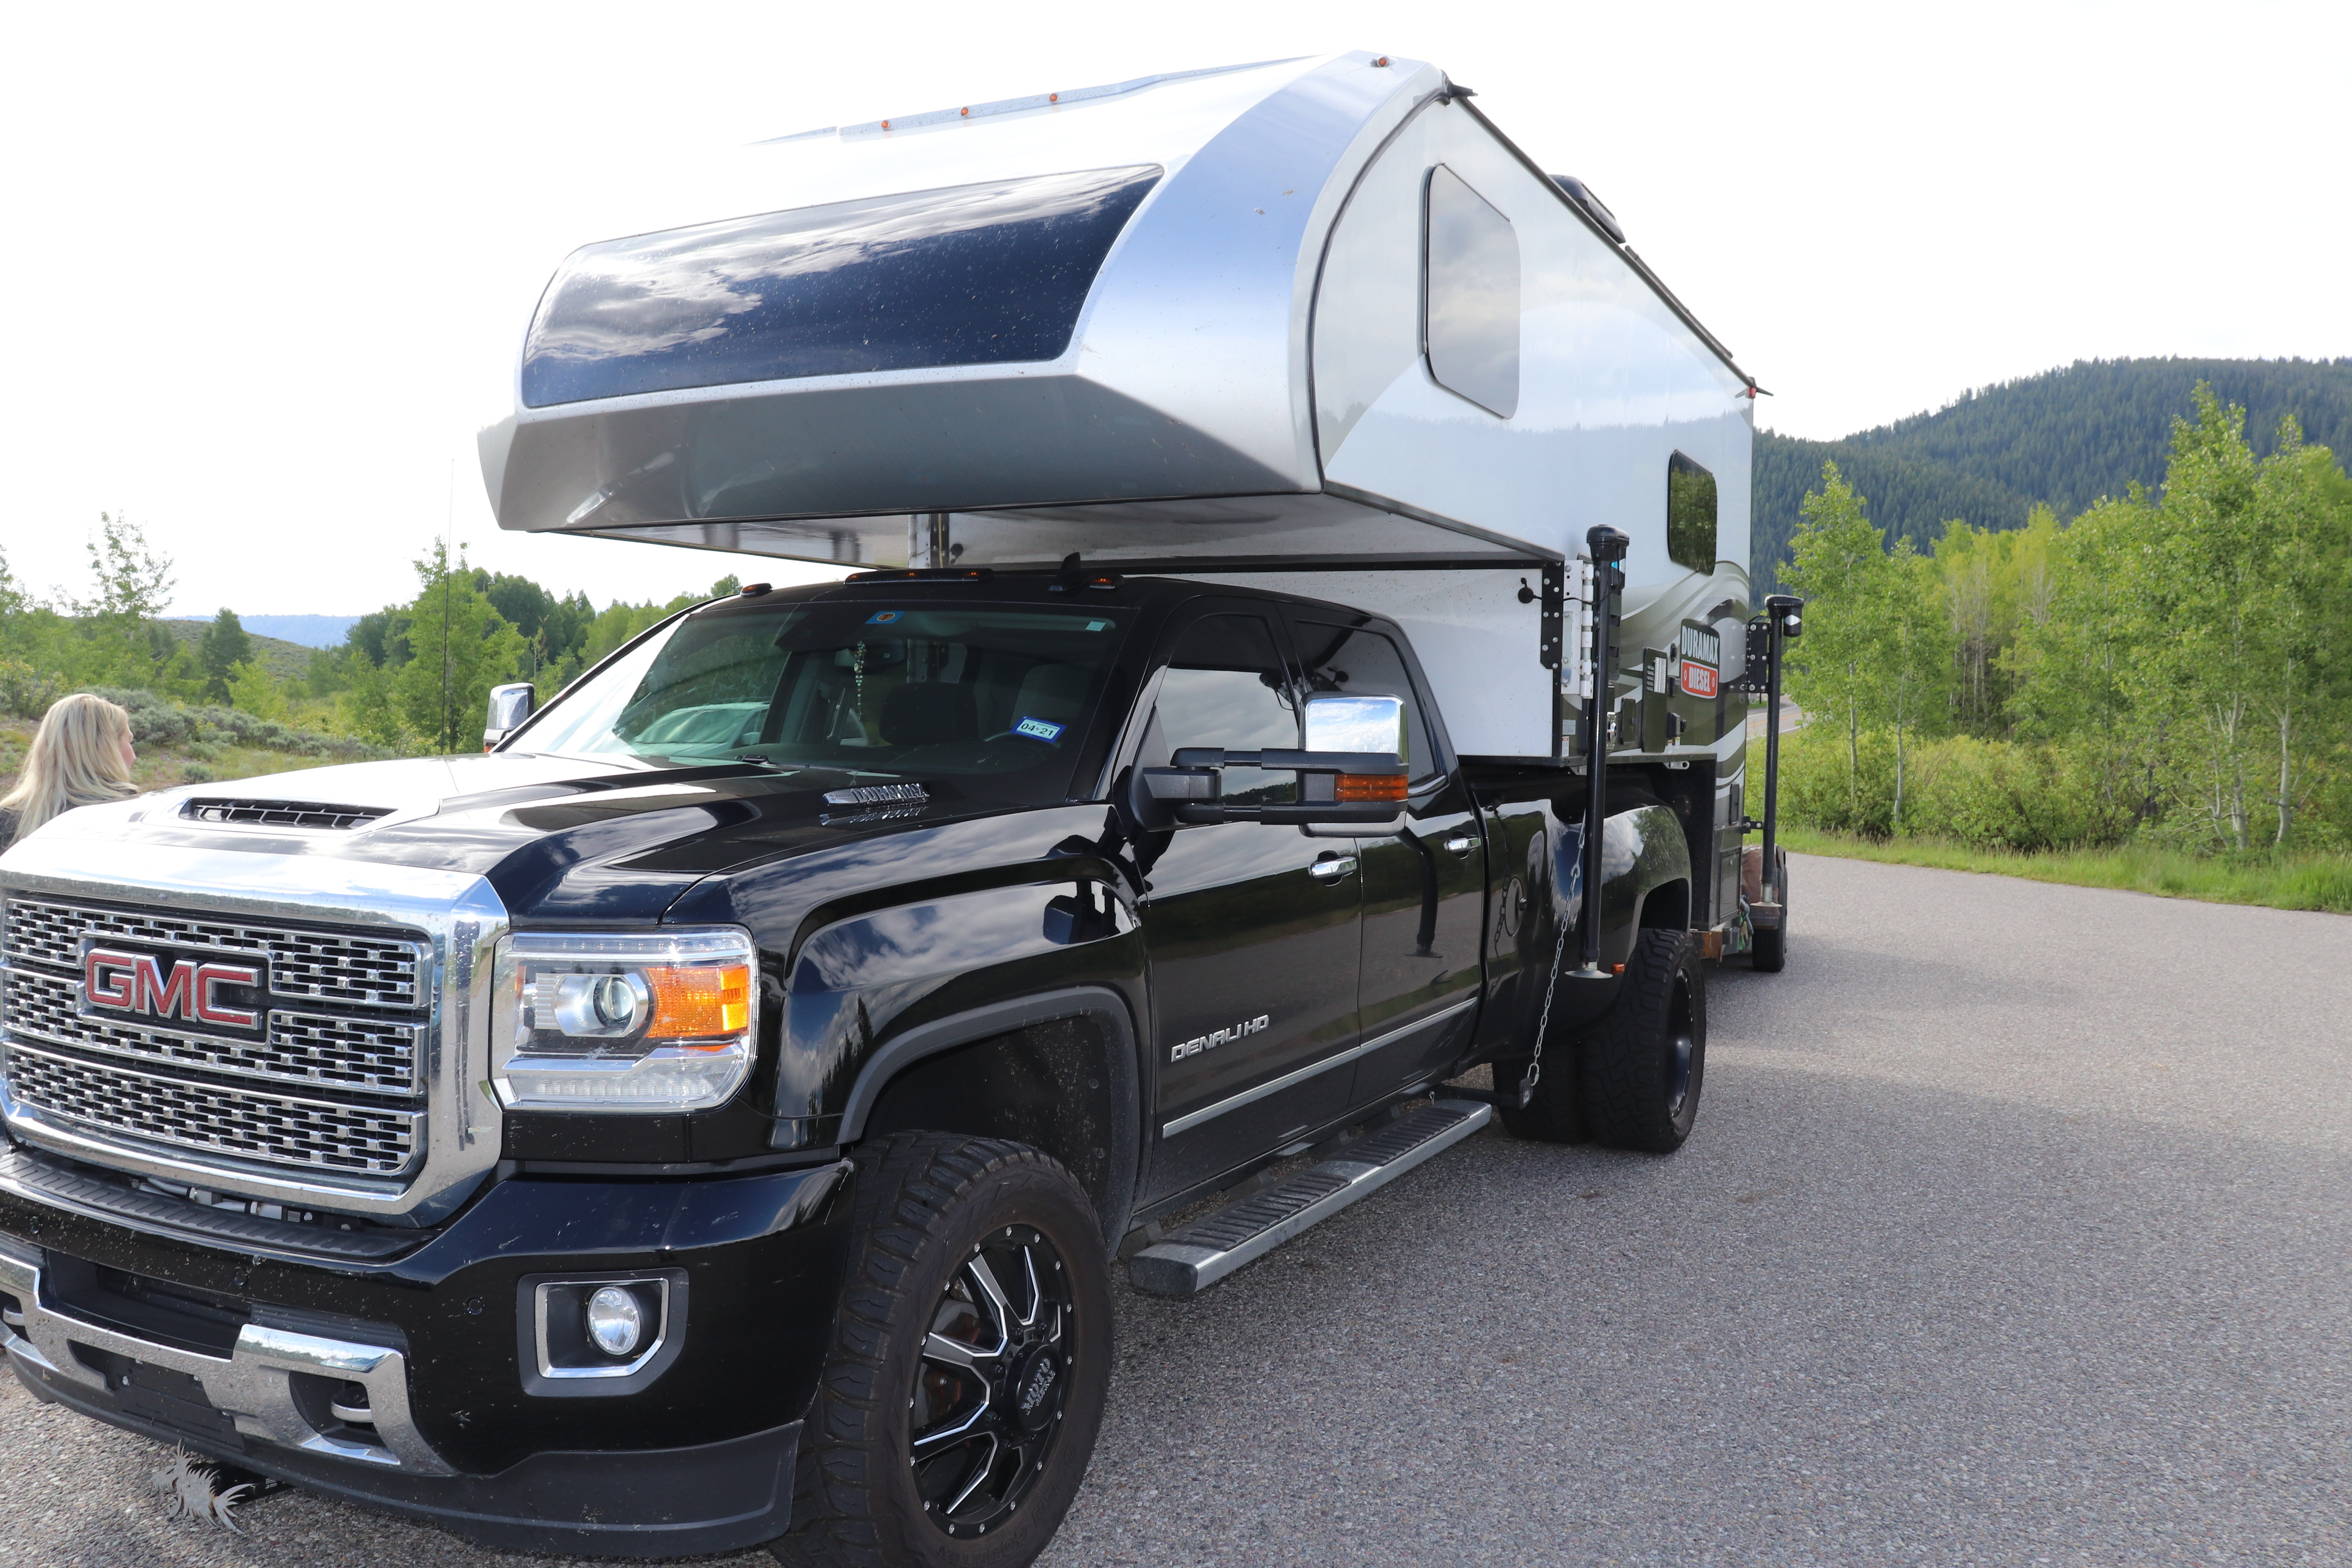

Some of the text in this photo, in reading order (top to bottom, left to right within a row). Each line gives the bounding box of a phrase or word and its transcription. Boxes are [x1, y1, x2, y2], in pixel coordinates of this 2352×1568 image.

[1682, 625, 1719, 665] DURAMAX
[1689, 667, 1711, 693] DIESEL
[1021, 723, 1036, 731] 04
[1039, 728, 1054, 736] 21
[850, 782, 930, 804] DURAMAX
[85, 947, 261, 1030] GMC
[1171, 1014, 1269, 1062] DENALI HD
[1020, 1357, 1051, 1416] MOTO
[936, 1442, 1077, 1568] OPEN COUNTRY
